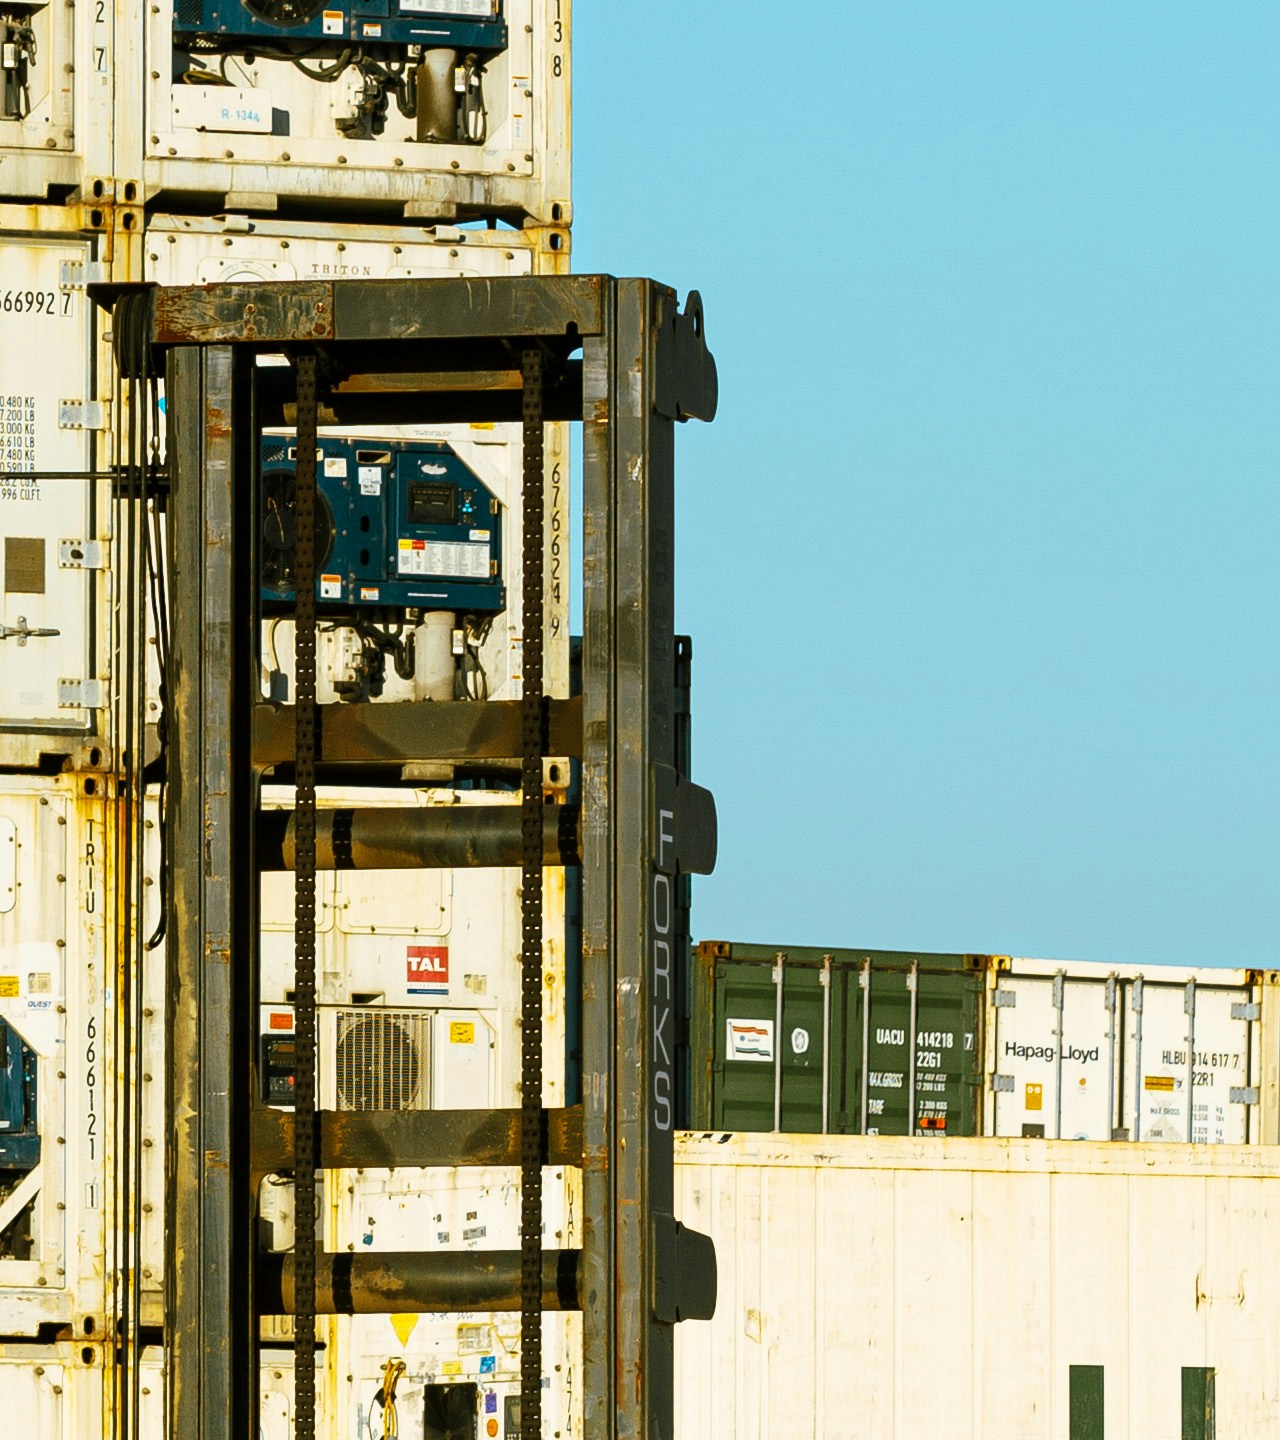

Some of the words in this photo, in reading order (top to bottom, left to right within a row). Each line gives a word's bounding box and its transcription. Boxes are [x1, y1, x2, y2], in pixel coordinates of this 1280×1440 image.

[311, 264, 371, 276] TRITON
[24, 398, 35, 408] KG
[24, 411, 34, 421] LB
[24, 424, 35, 434] KG
[24, 450, 35, 460] KG
[550, 462, 561, 606] 676624
[85, 819, 95, 914] TRIU
[407, 956, 447, 972] TAL
[653, 809, 675, 1132] FORKS
[876, 1029, 905, 1046] UACU
[916, 1032, 954, 1049] 414218
[1005, 1041, 1099, 1063] Hapag-Lloyd
[1162, 1050, 1187, 1066] HLBU
[1211, 1054, 1228, 1069] 617
[86, 1016, 97, 1160] 666121
